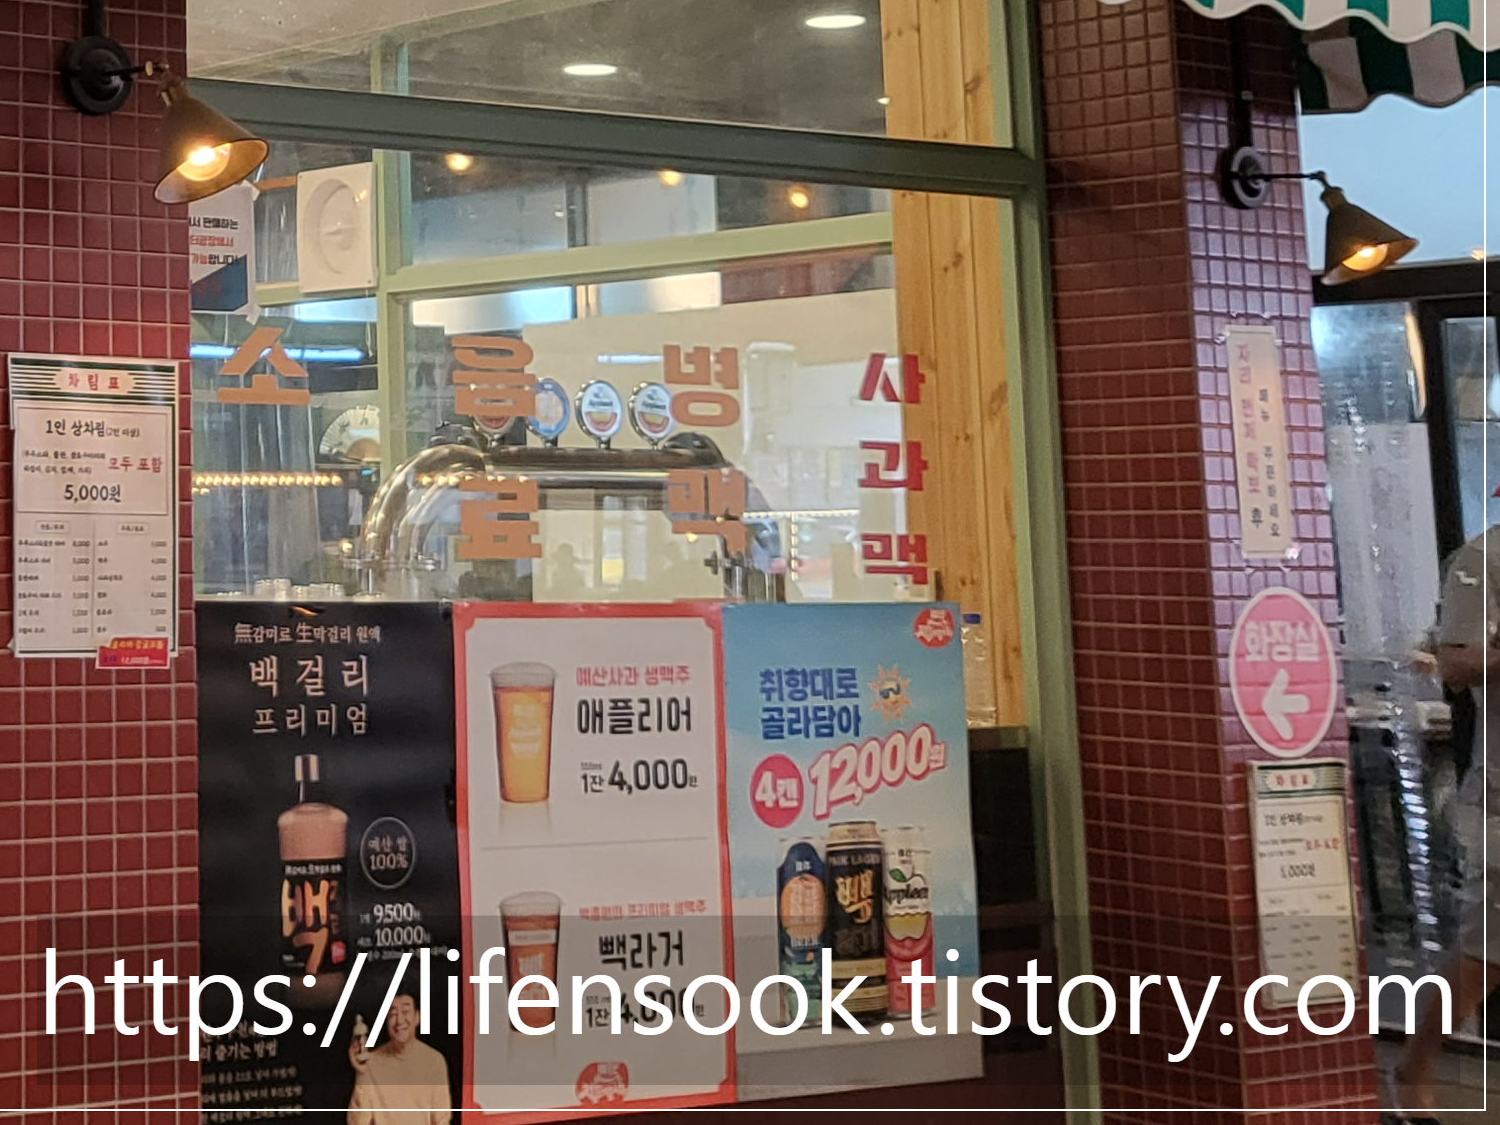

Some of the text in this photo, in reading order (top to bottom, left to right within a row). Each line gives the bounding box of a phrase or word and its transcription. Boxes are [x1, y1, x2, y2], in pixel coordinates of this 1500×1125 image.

[68, 373, 121, 391] 차림표
[45, 419, 66, 435] 1인
[71, 420, 105, 437] 상차림
[108, 456, 163, 473] 모두 포함
[64, 484, 122, 503] 5,000원
[1244, 619, 1320, 663] 화장실
[249, 654, 369, 698] 백걸리
[576, 665, 691, 687] 예산사과 생맥주
[759, 668, 860, 702] 취향대로
[252, 703, 368, 736] 프리미엄
[577, 696, 691, 734] 애플리어
[761, 704, 862, 740] 골라담아
[581, 758, 698, 795] 1잔 4,000원
[755, 770, 800, 809] 4캔
[370, 853, 408, 870] 100%
[599, 930, 684, 971] 빽라거
